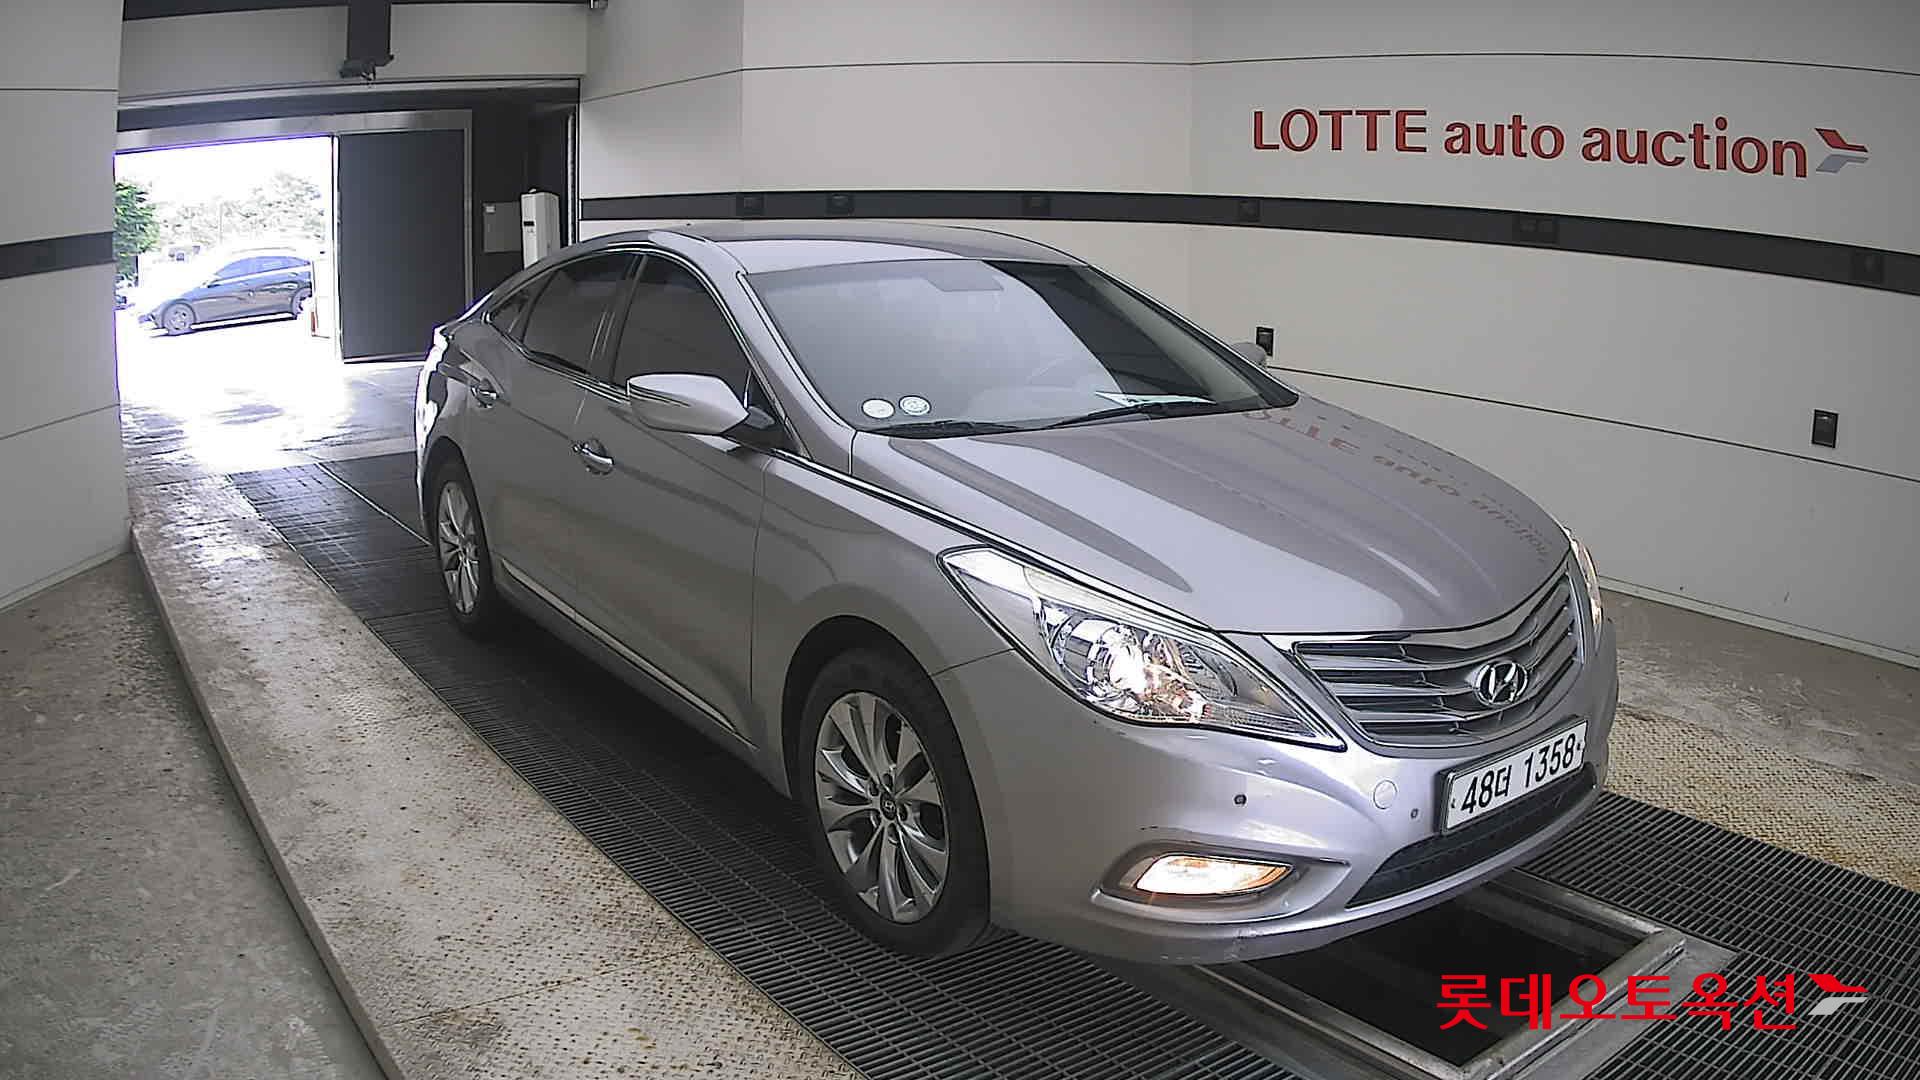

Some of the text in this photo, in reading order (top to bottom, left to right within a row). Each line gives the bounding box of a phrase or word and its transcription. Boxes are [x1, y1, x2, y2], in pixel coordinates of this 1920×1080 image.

[1253, 109, 1809, 178] LOTTE auto auction
[1460, 733, 1576, 814] 48더 1358
